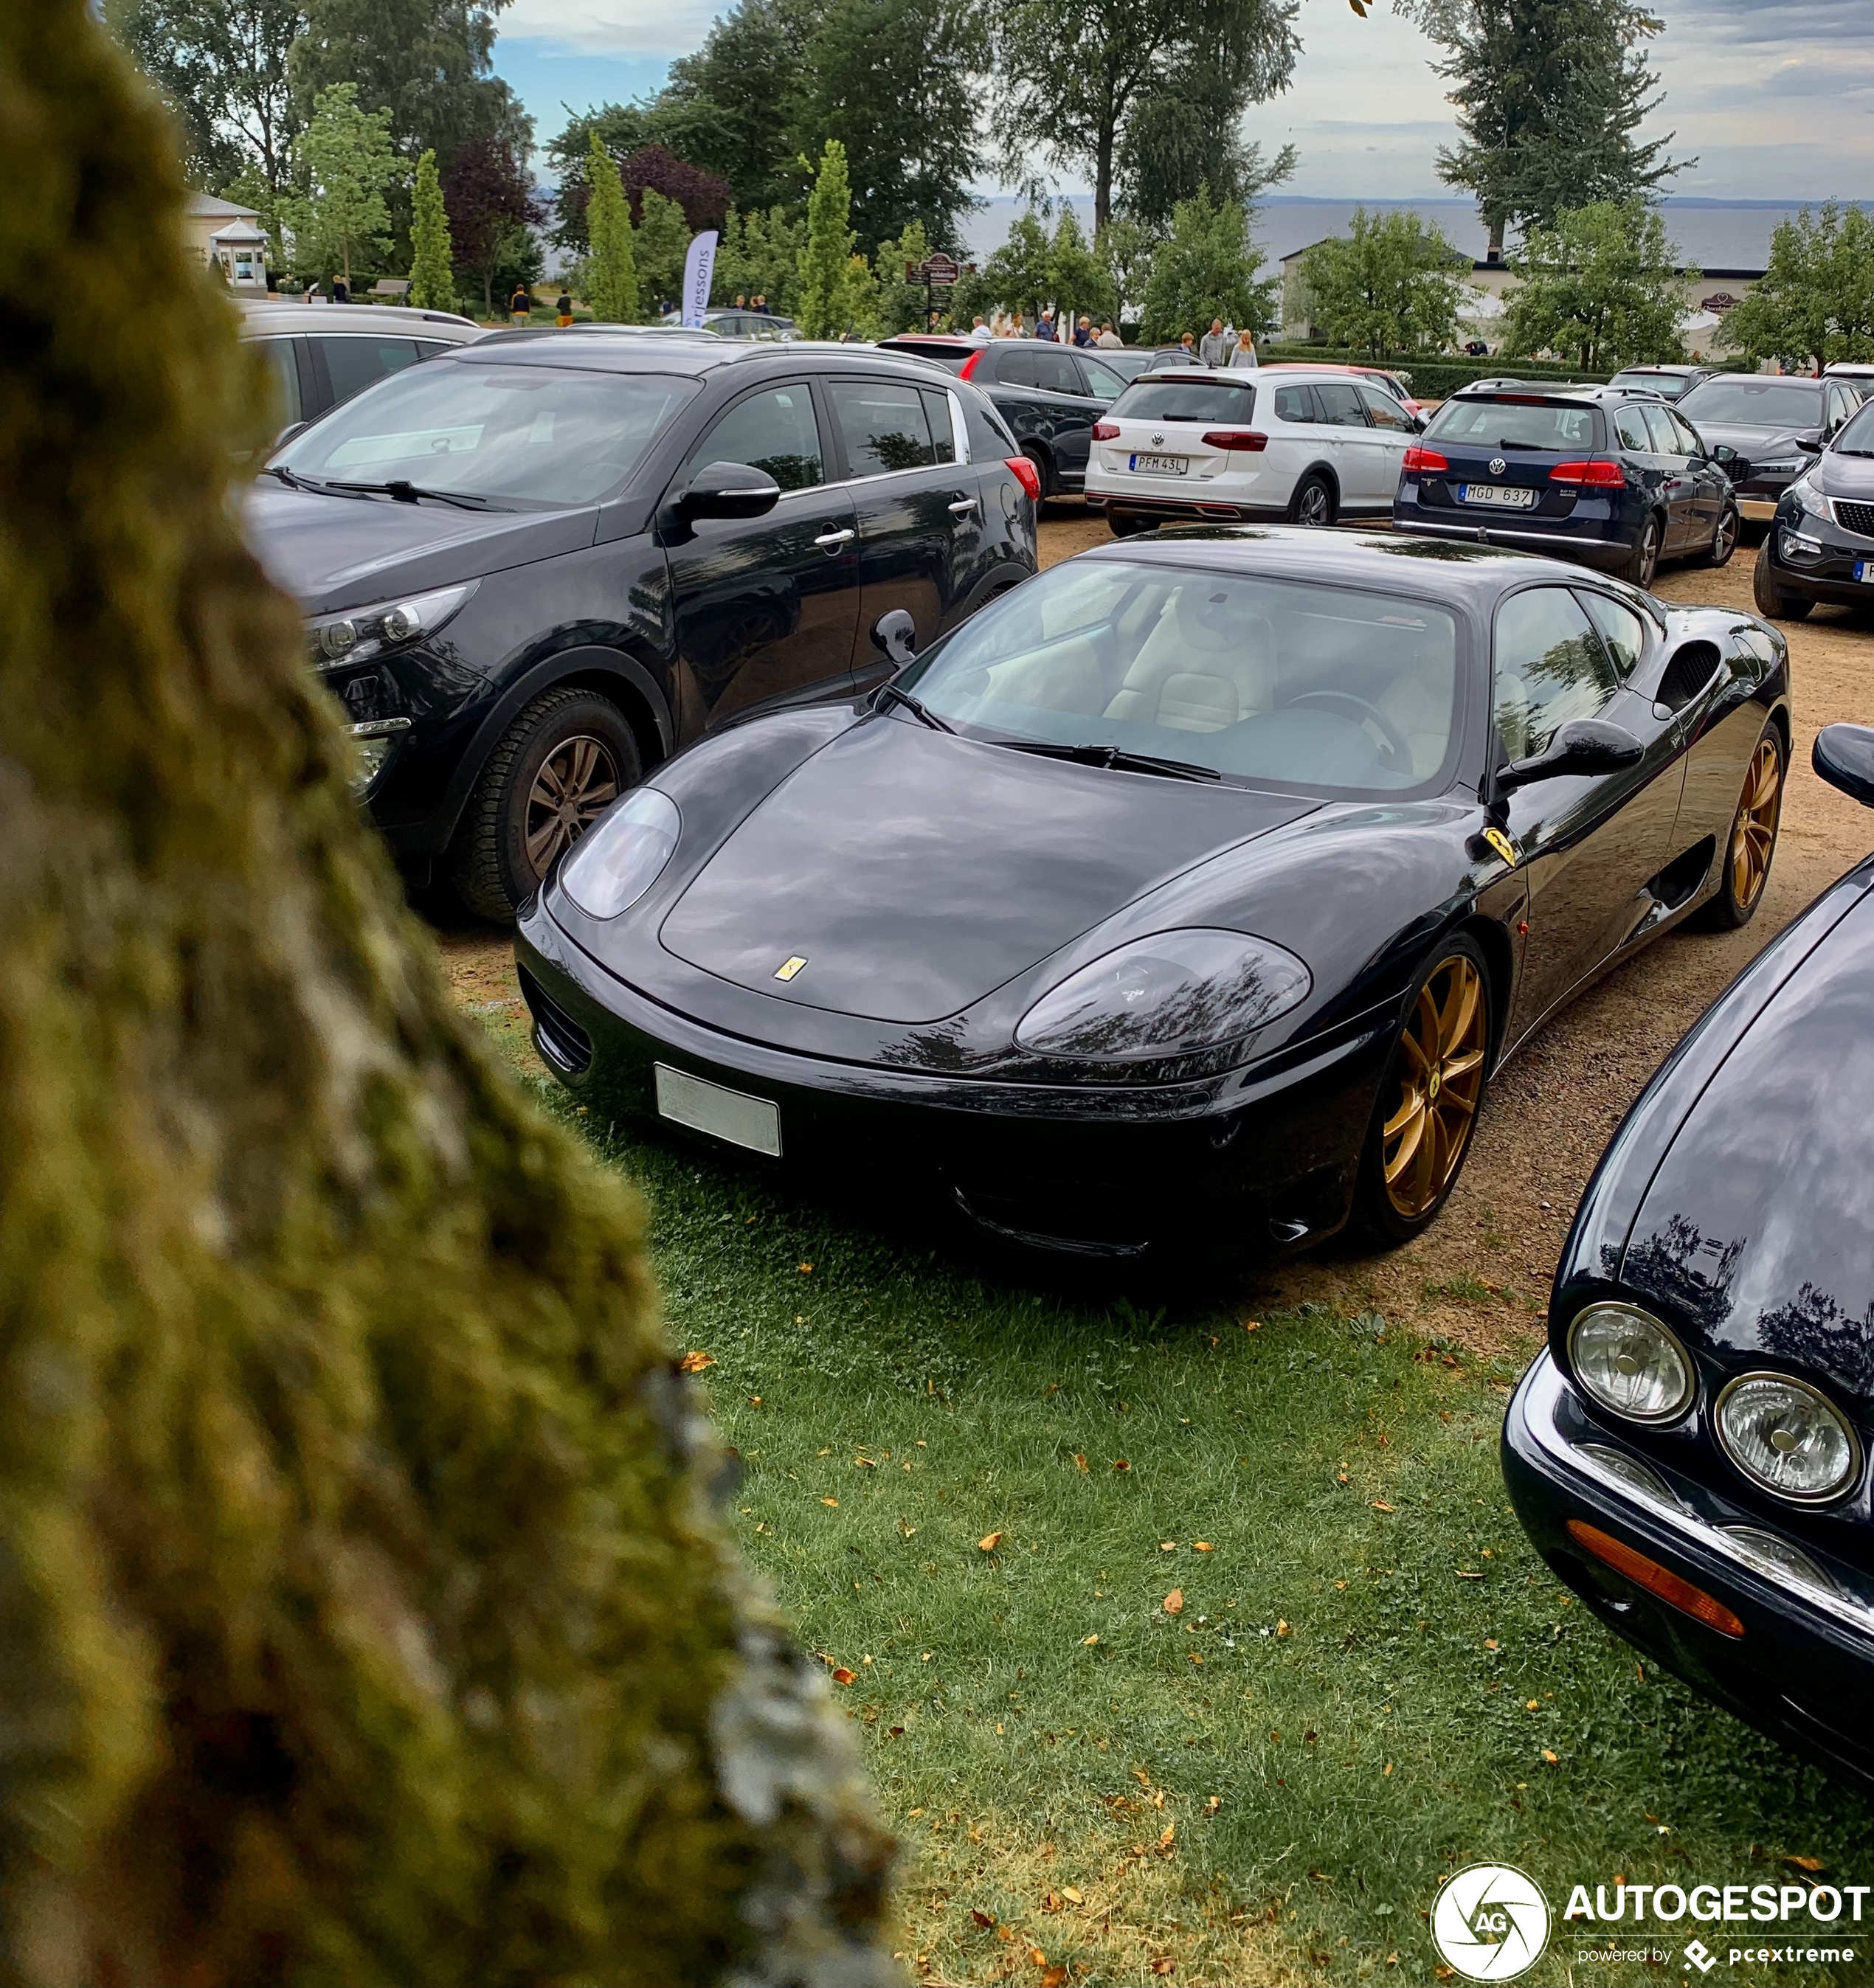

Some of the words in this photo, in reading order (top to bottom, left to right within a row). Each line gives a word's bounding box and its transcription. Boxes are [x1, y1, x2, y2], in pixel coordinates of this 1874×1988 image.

[1138, 457, 1159, 468] PFM
[1162, 458, 1181, 471] 43L
[1467, 485, 1493, 499] MGD
[1503, 489, 1530, 503] 637
